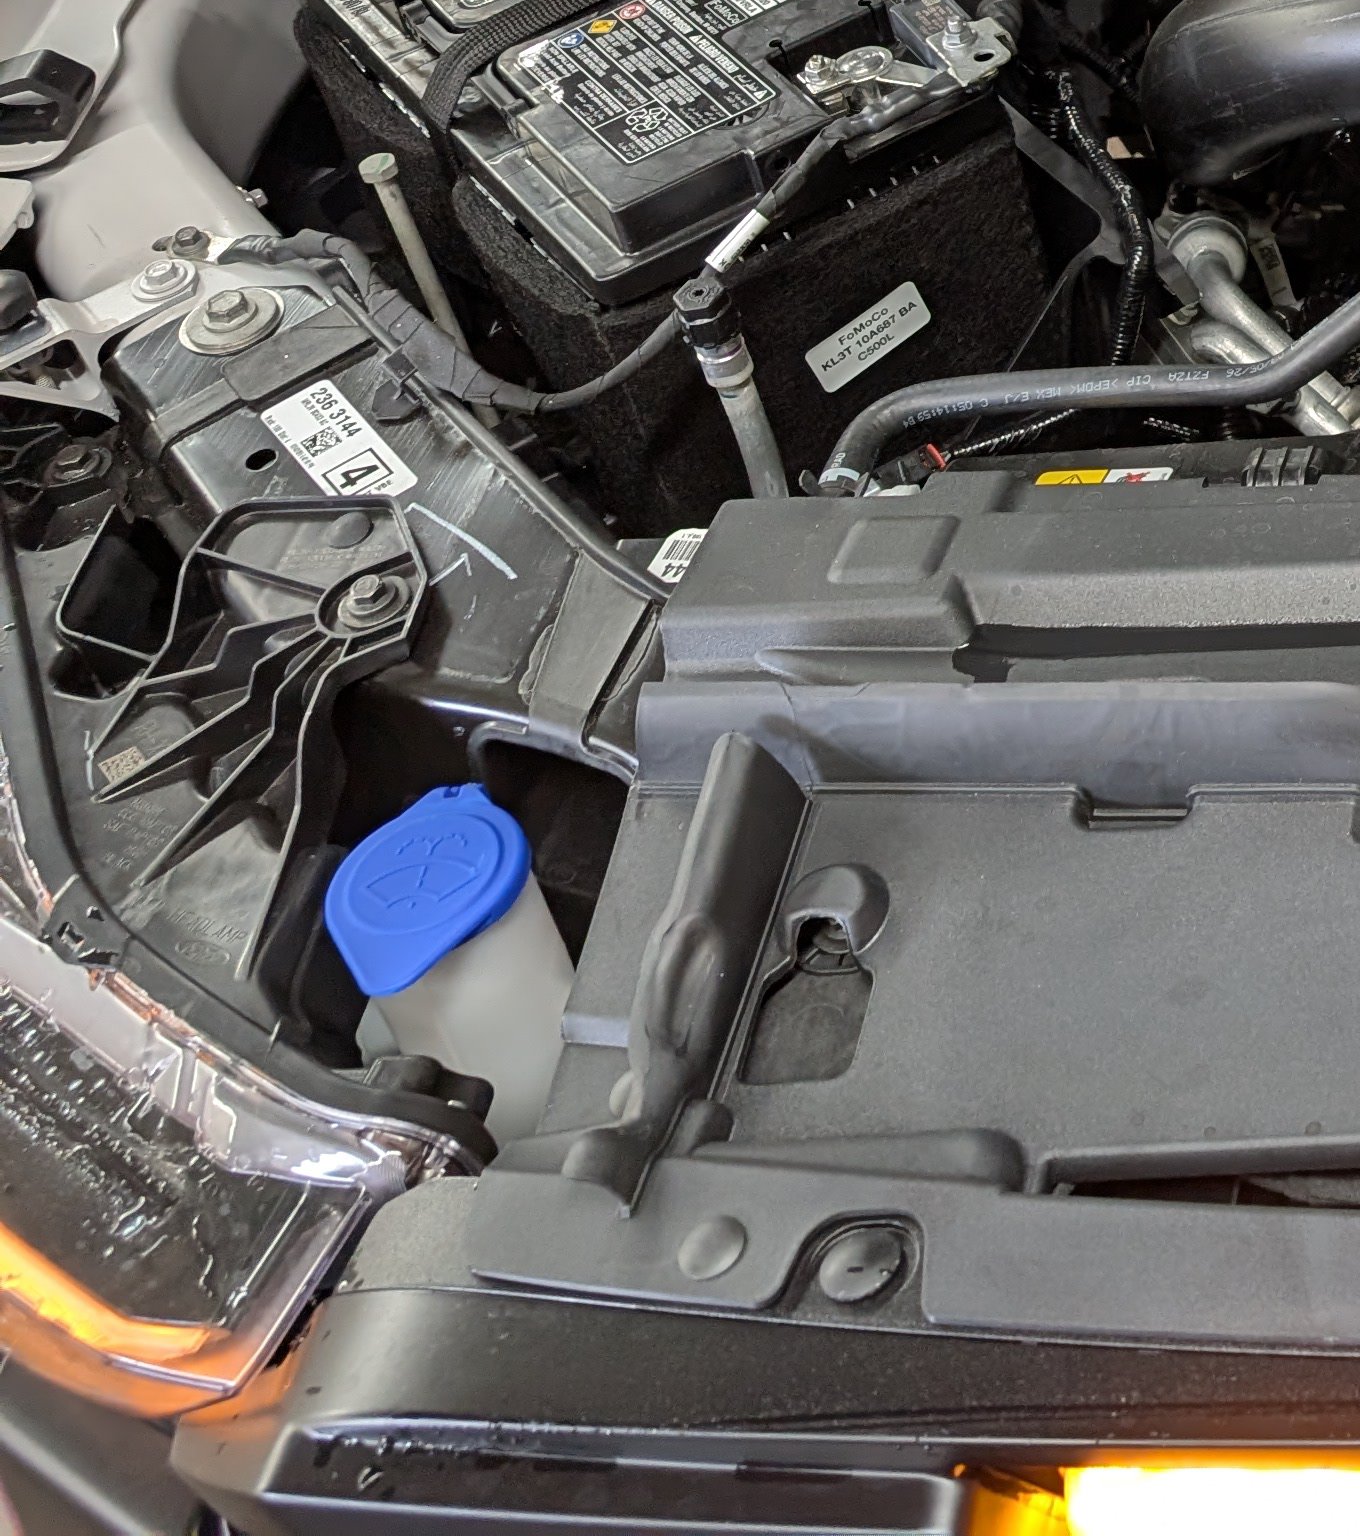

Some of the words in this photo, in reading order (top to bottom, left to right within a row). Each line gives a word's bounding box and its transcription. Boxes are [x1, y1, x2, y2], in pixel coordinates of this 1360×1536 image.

[821, 346, 852, 372] KL3T
[855, 314, 897, 348] 10A687
[898, 301, 918, 317] BA
[838, 307, 889, 345] FoMoCo
[857, 333, 895, 361] C500L
[1127, 374, 1151, 387] CIP
[980, 397, 989, 408] C
[1004, 391, 1029, 404] E/J
[1037, 386, 1062, 400] MEX
[310, 387, 339, 411] 236
[329, 408, 363, 438] 3144
[917, 400, 974, 424] 05:14:59
[339, 464, 380, 489] 4
